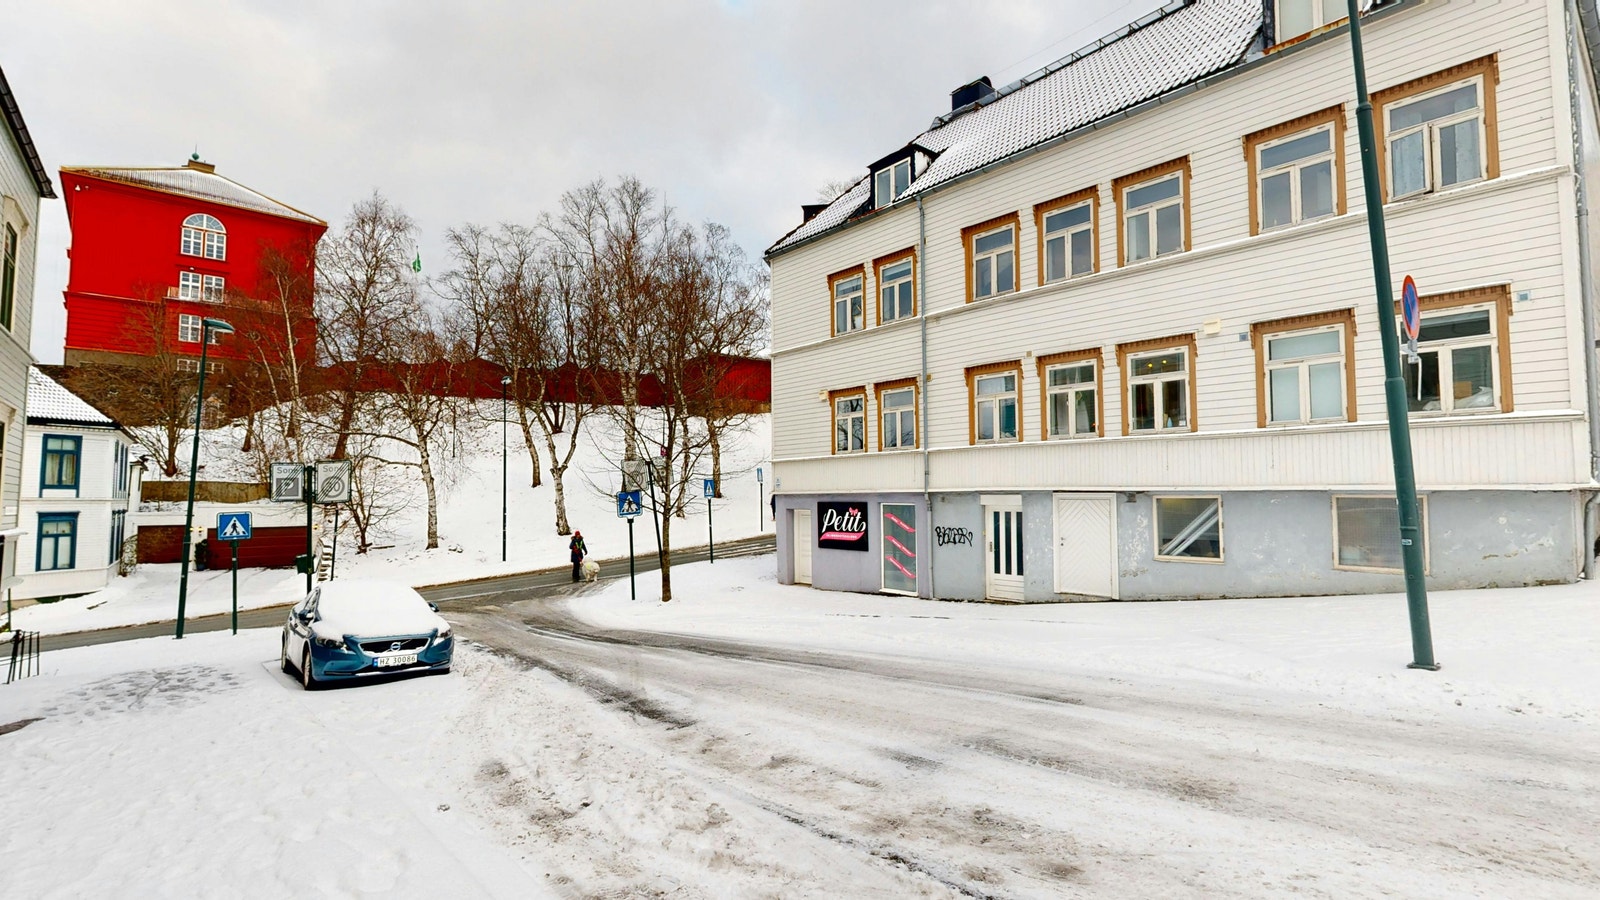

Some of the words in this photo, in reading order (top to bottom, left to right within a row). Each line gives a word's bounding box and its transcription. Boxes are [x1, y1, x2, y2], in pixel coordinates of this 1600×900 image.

[821, 508, 867, 533] Petit
[379, 657, 390, 665] HZ
[393, 655, 416, 664] 30086
